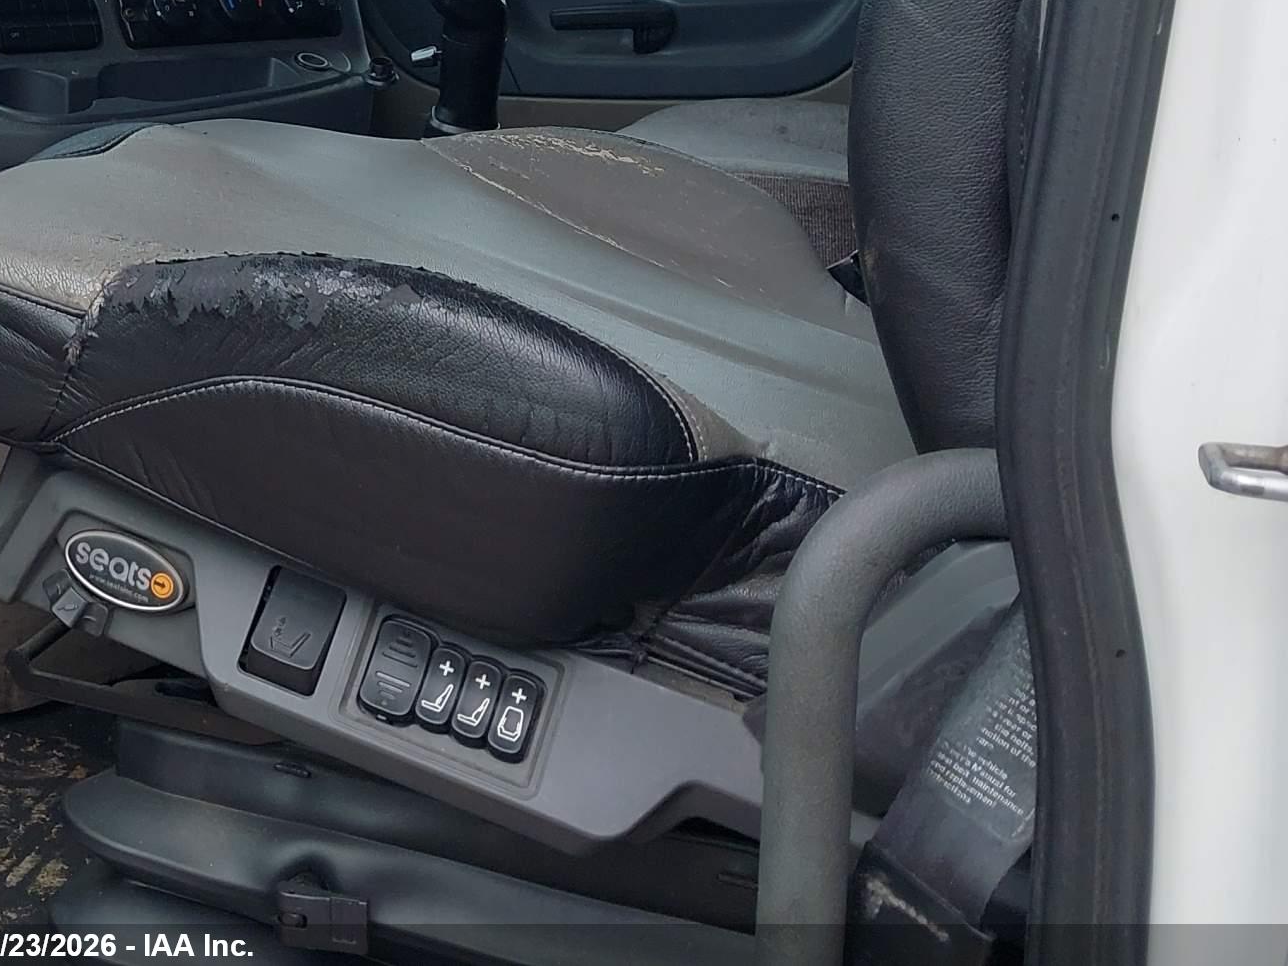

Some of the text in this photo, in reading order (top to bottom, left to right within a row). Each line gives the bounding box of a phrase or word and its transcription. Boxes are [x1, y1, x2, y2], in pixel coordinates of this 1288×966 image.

[75, 542, 152, 590] seats
[1020, 753, 1036, 768] the
[1003, 784, 1016, 798] for
